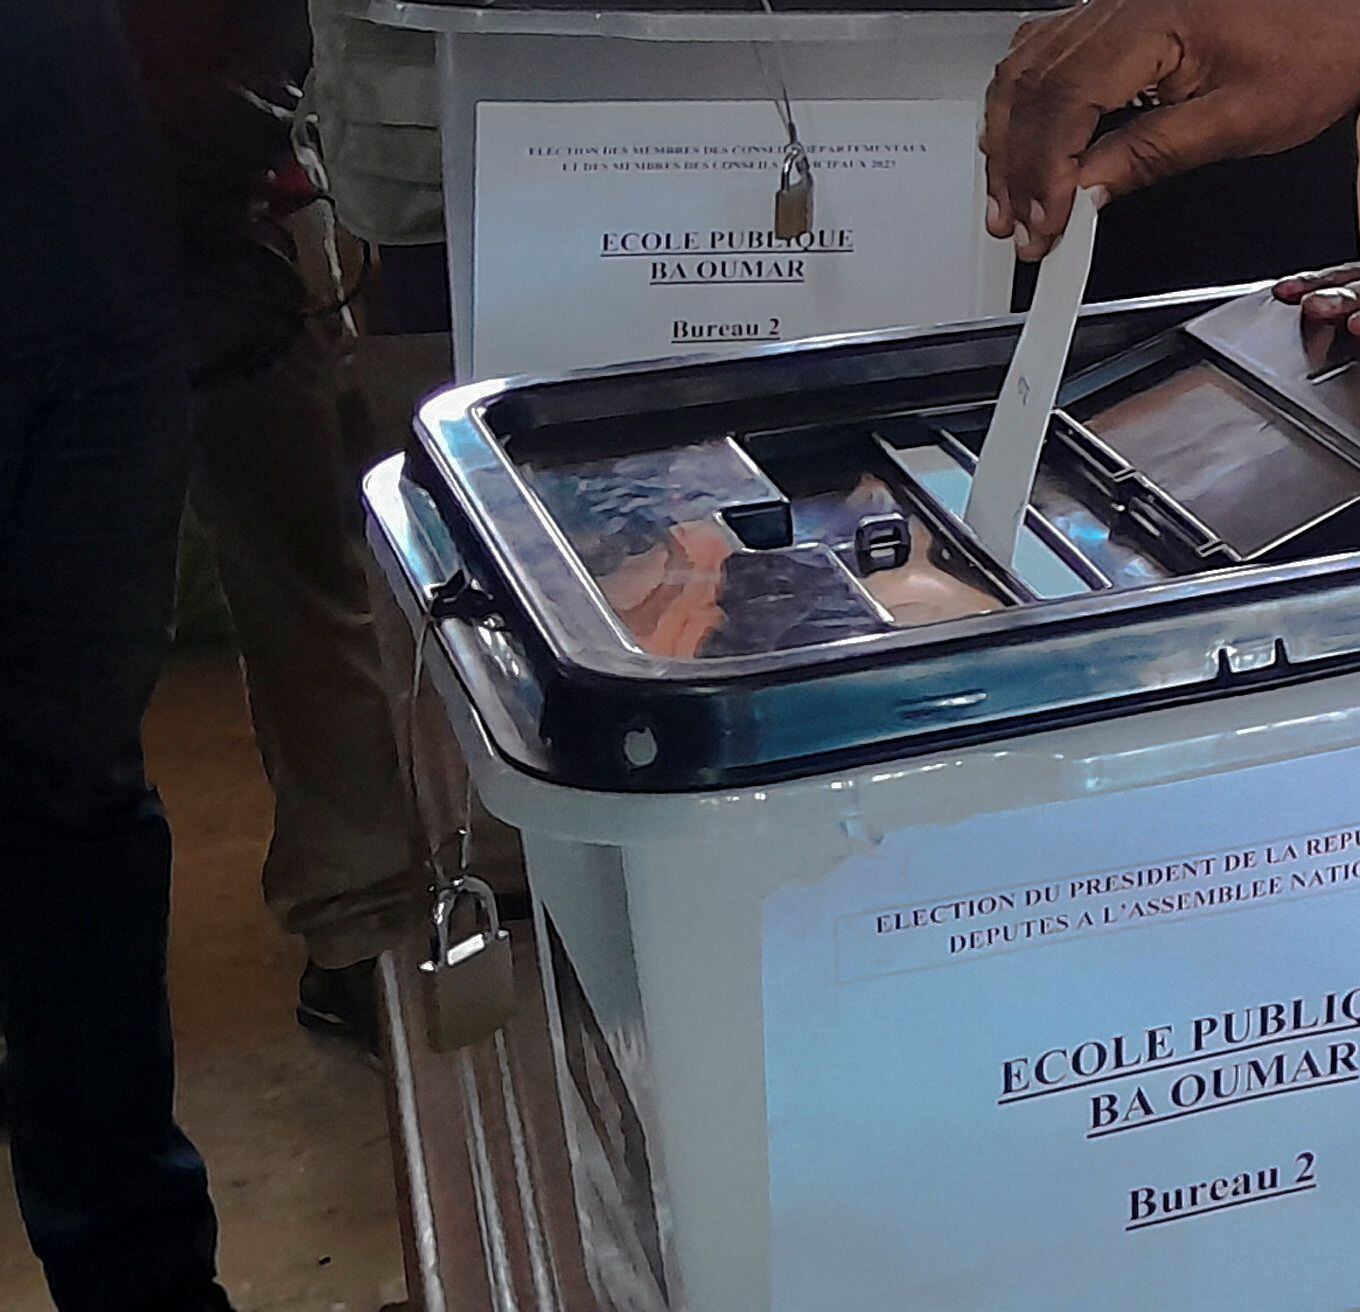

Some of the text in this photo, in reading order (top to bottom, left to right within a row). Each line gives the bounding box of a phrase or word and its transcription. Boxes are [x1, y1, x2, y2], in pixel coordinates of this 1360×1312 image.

[602, 232, 699, 253] ECOLE
[650, 259, 804, 280] BA OUMAR
[672, 318, 780, 339] Bureau 2
[875, 892, 1016, 935] ELECTION
[1025, 884, 1060, 907] DU
[1069, 856, 1217, 899] PRESIDENT
[1224, 850, 1258, 873] DE
[1265, 843, 1299, 864] LA
[949, 913, 1070, 954] DEPUTES
[1076, 911, 1095, 929] A
[1103, 875, 1283, 924] L'ASSEMBLEE
[1000, 1024, 1175, 1097] ECOLE
[1089, 1040, 1359, 1129] BA OUMAR
[1128, 1151, 1316, 1222] Bureau 2
